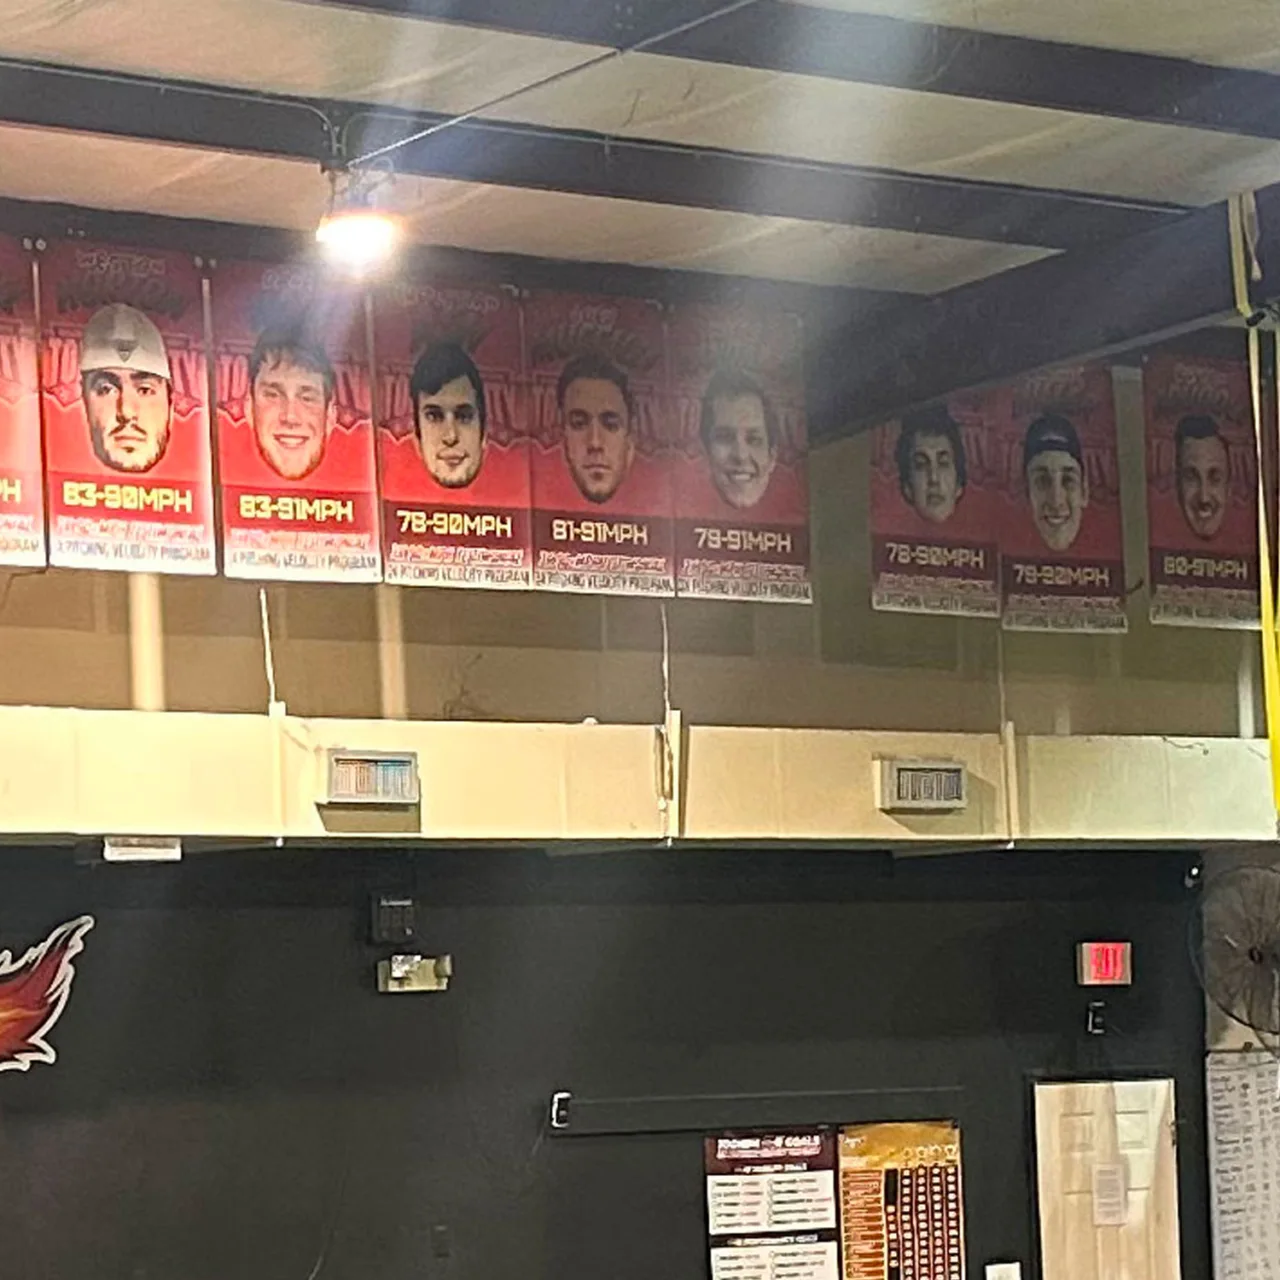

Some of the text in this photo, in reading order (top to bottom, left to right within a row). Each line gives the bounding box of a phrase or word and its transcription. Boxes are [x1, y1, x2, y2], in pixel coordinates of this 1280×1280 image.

[63, 481, 194, 514] 83-90MPH
[239, 494, 355, 523] 83-91MPH
[396, 509, 513, 538] 78-90MPH
[552, 518, 649, 545] 81-91MPH
